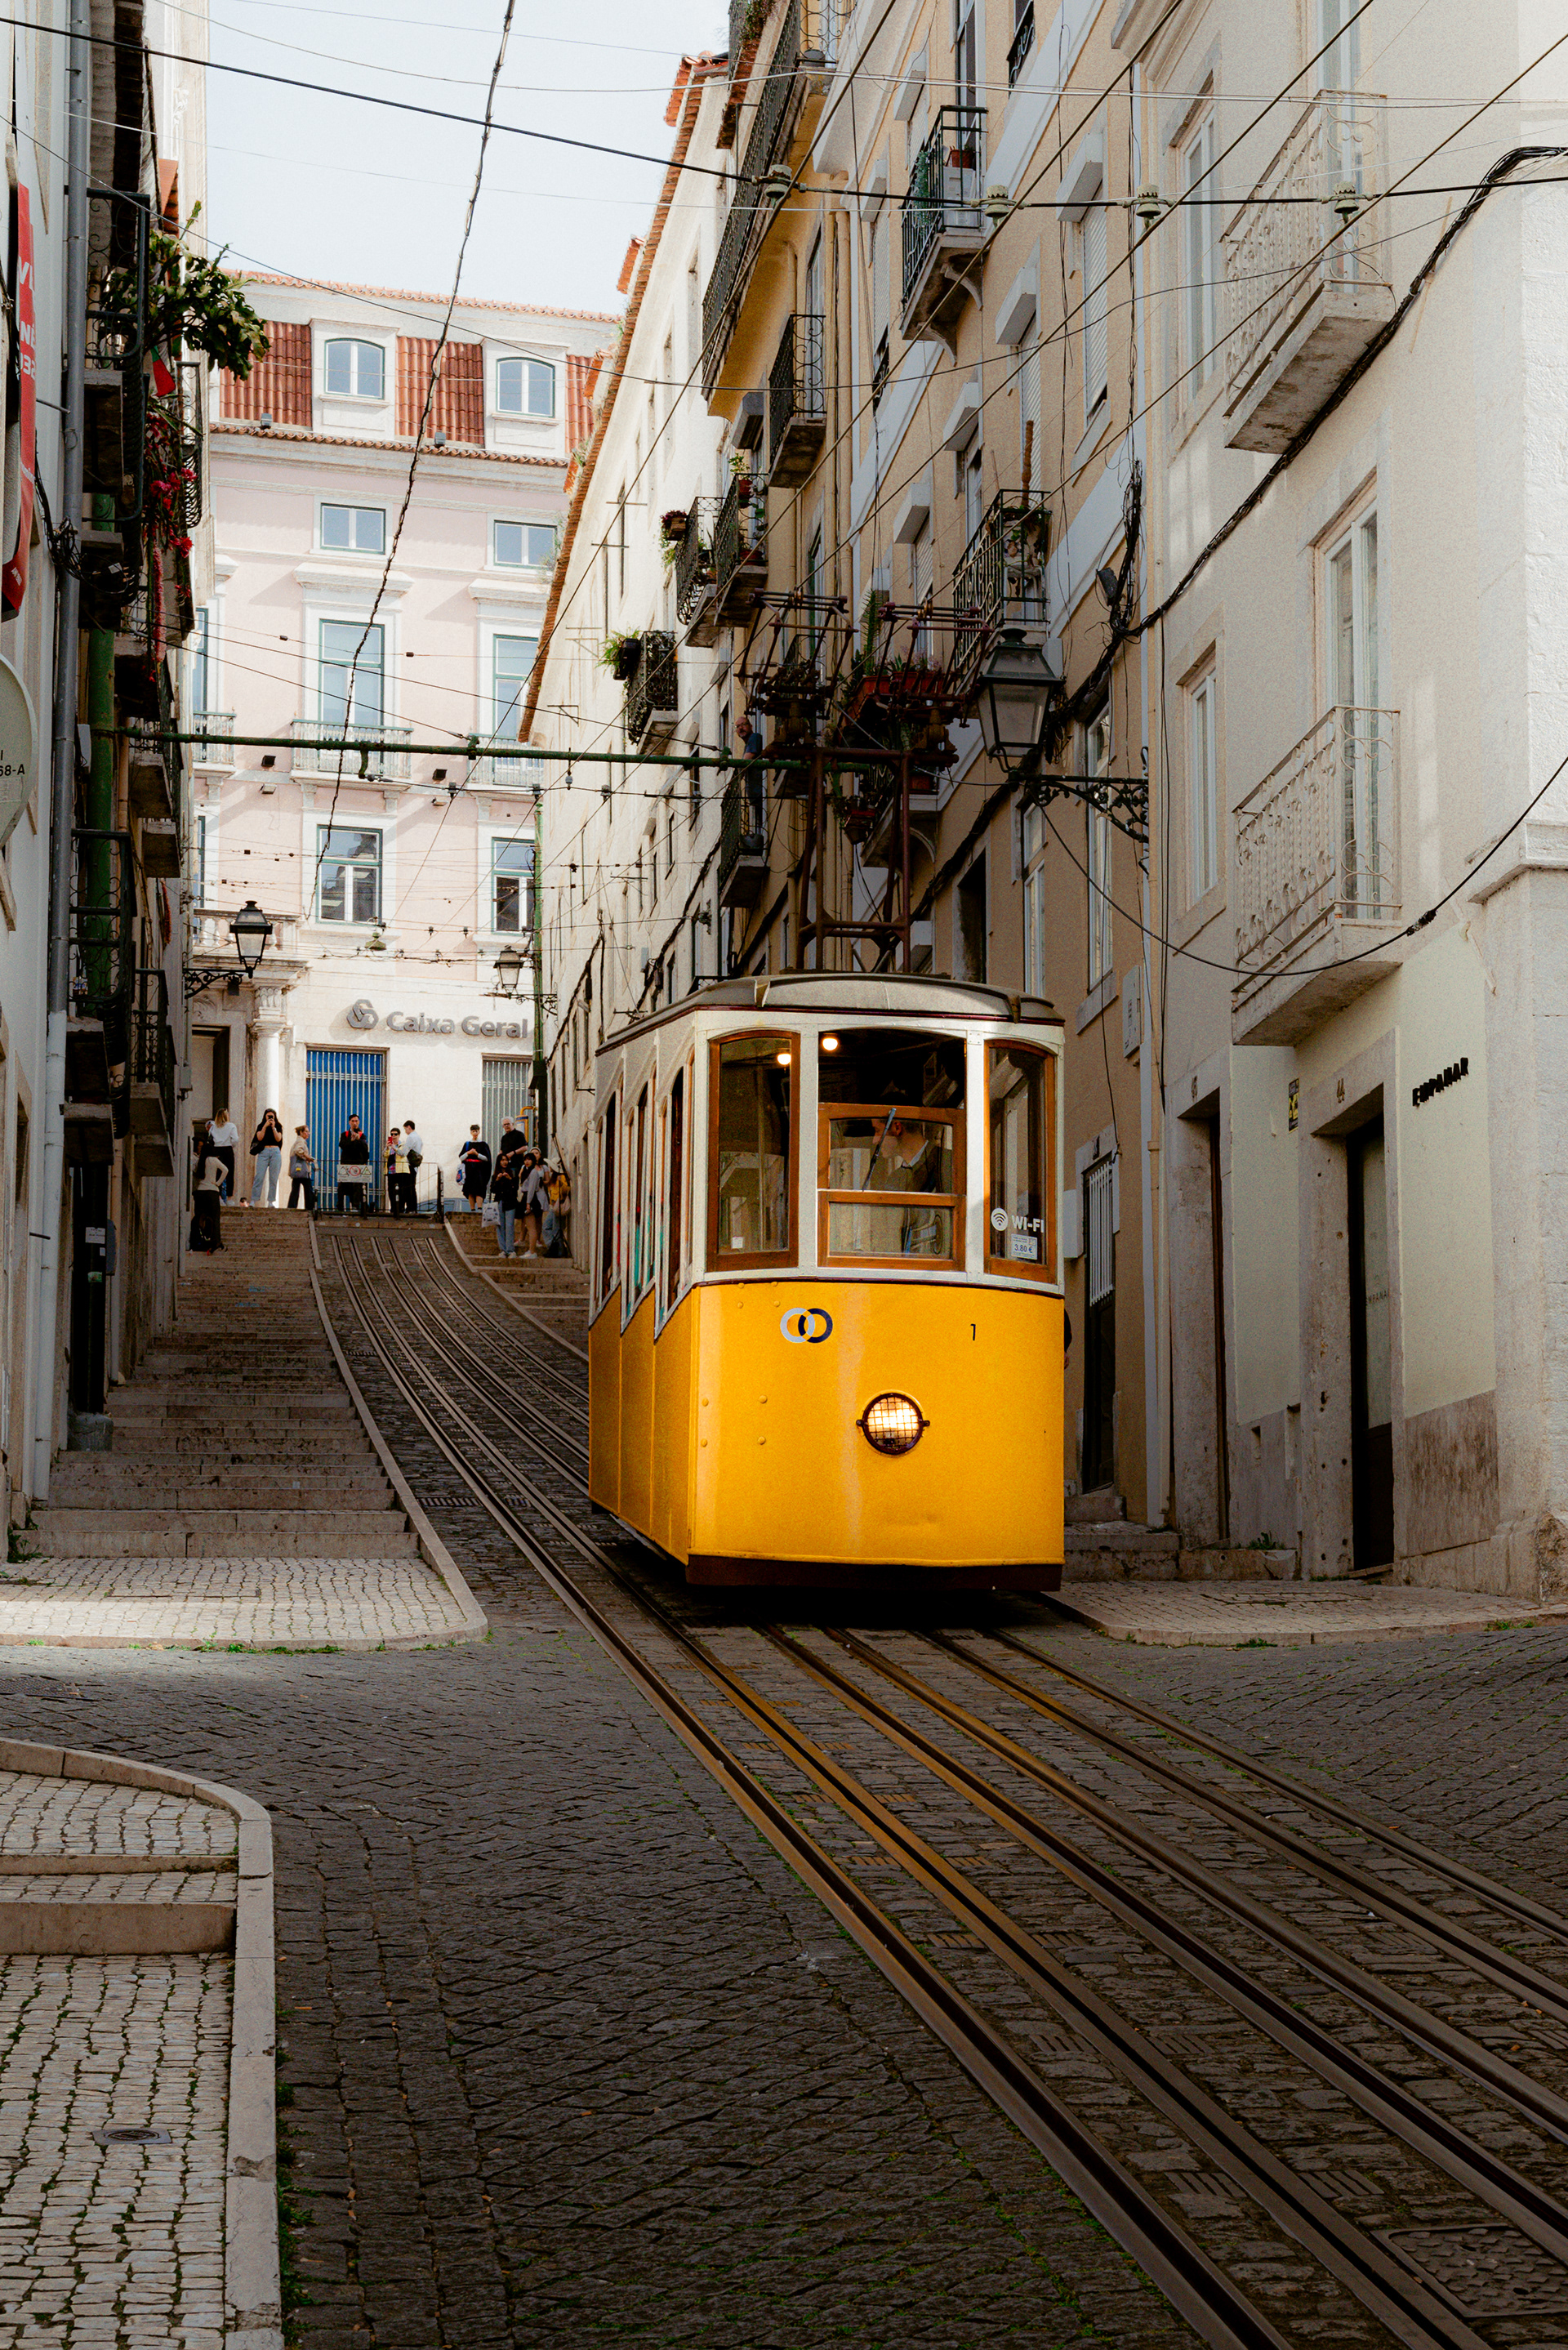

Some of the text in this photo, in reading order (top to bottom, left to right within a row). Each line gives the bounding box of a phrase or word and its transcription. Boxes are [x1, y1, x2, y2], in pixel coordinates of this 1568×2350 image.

[387, 1012, 528, 1038] Caixa Geral
[1012, 1215, 1045, 1233] WI-FI
[1014, 1244, 1027, 1252] 3.80
[970, 1323, 976, 1340] 1
